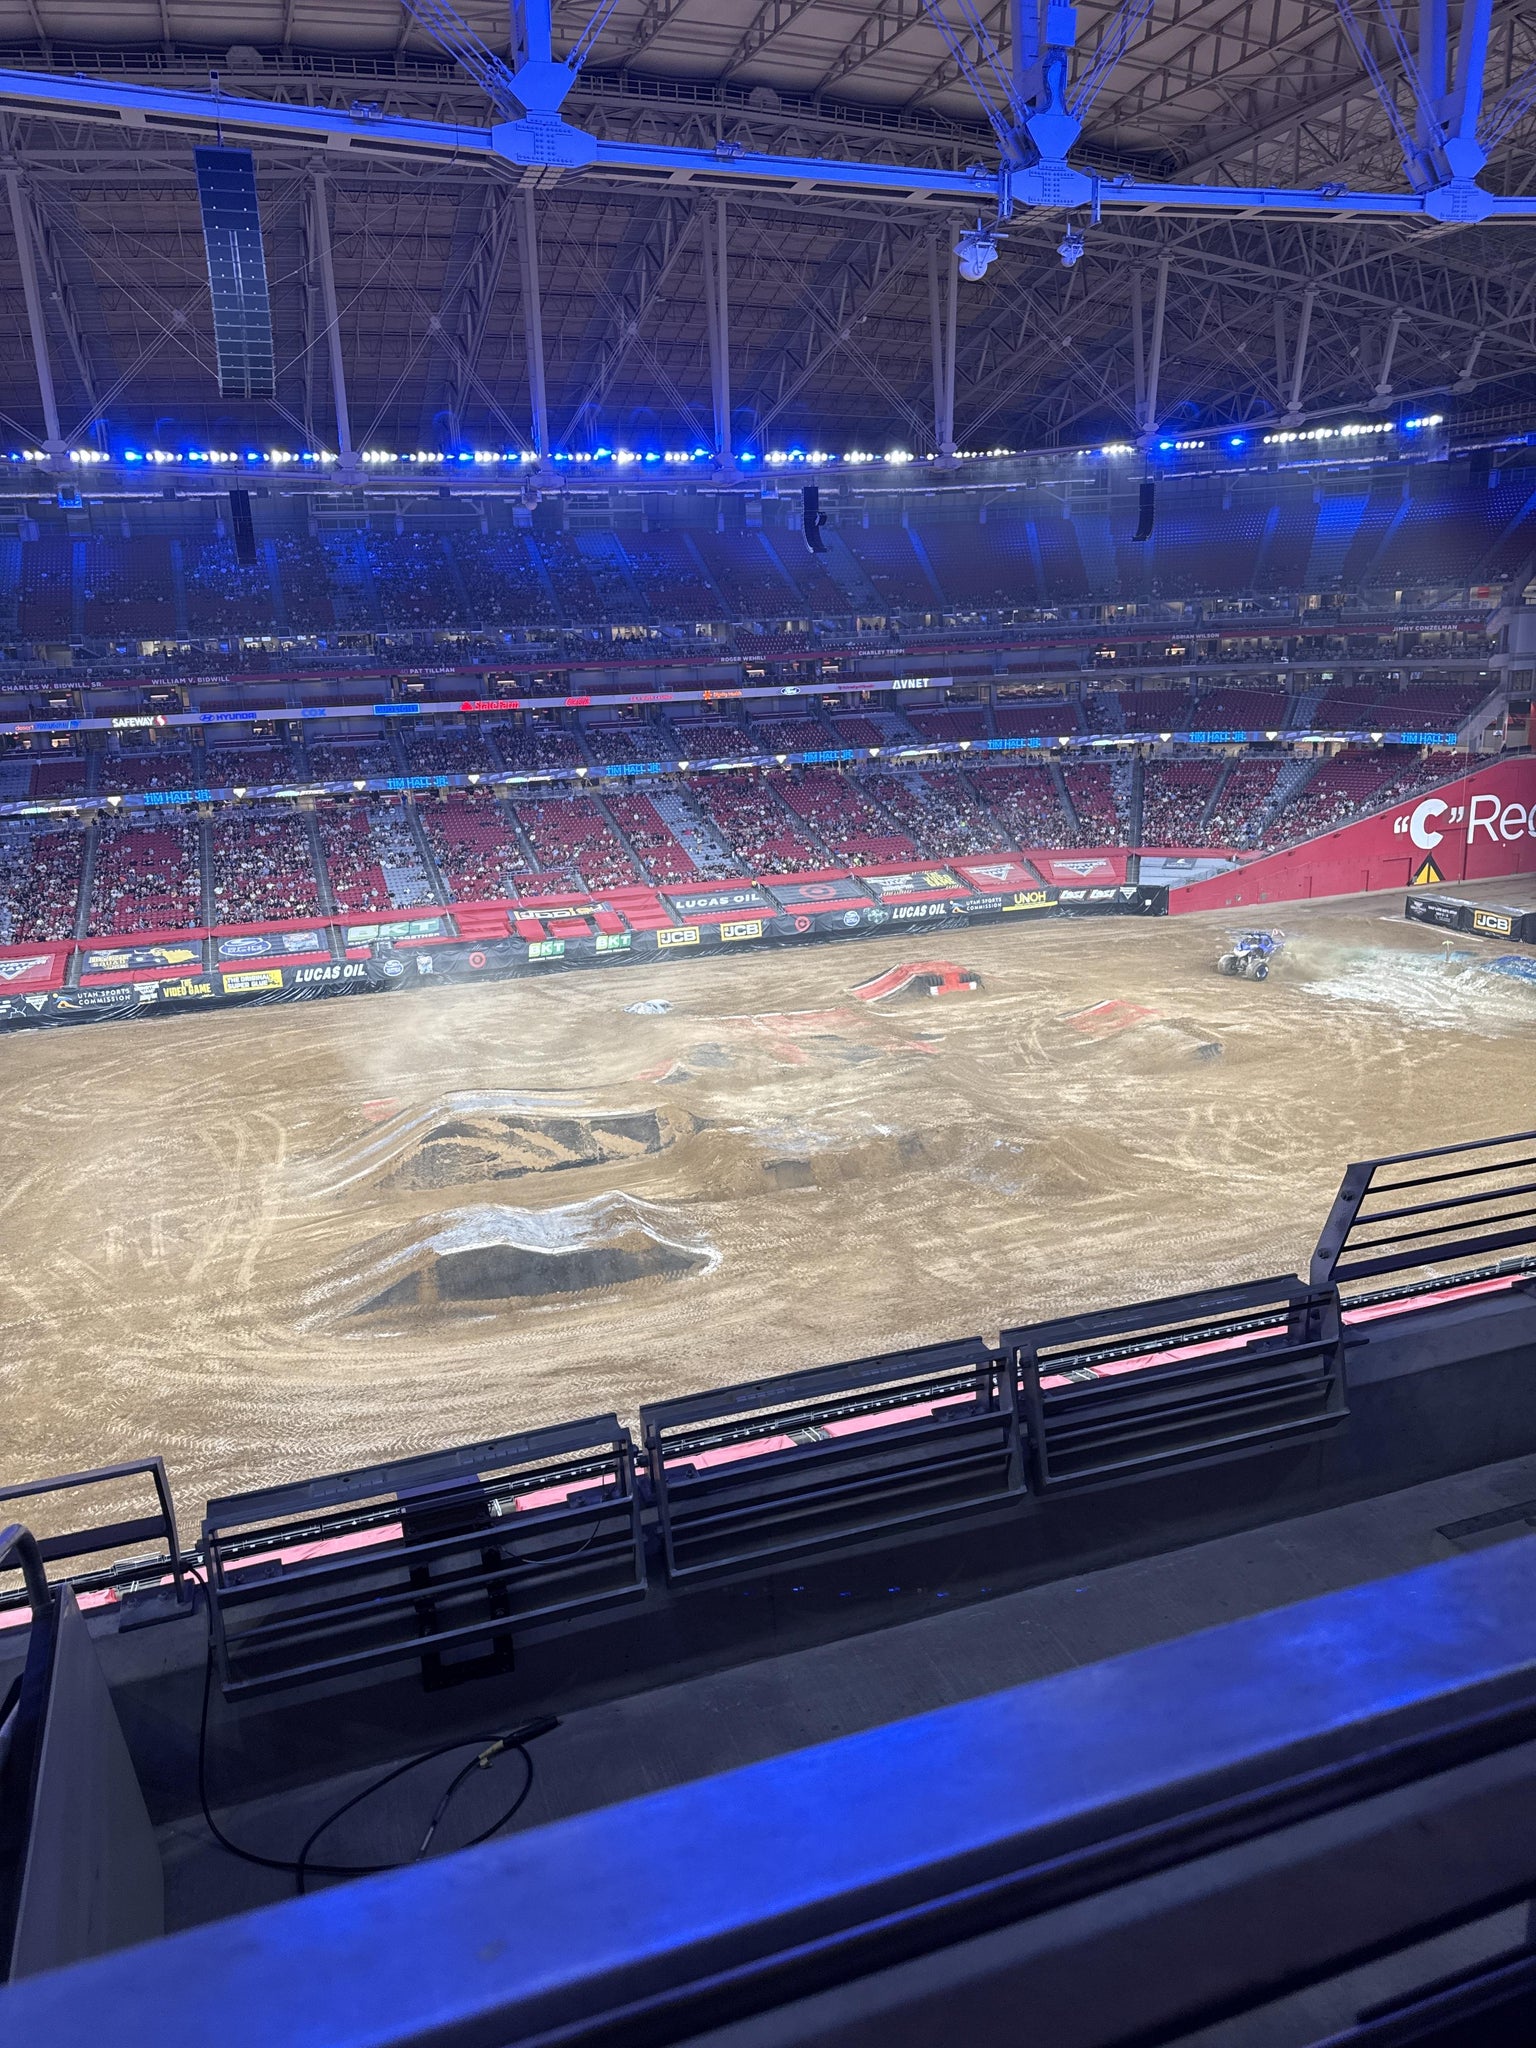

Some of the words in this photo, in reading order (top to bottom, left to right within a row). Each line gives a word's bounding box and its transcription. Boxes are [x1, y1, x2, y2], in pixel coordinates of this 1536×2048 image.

[892, 678, 930, 689] AVNET
[217, 712, 257, 721] HYUNDAI
[301, 708, 326, 717] COX
[112, 716, 154, 727] SAFEWAY
[1189, 731, 1205, 742] TIM
[1207, 731, 1230, 742] HALL
[1401, 732, 1417, 744] TIM
[1419, 732, 1443, 744] HALL
[988, 739, 1002, 749] TIM
[1004, 738, 1026, 749] HALL
[803, 752, 817, 763] TIM
[819, 751, 839, 761] HALL
[606, 765, 621, 776] TIM
[623, 764, 646, 775] HALL
[387, 778, 404, 790] TIM
[407, 777, 432, 788] HALL
[144, 793, 163, 805] TIM
[166, 791, 193, 803] HALL
[1467, 794, 1536, 844] Re
[676, 897, 728, 908] LUCAS
[1014, 891, 1046, 904] UNOH
[893, 905, 927, 919] LUCAS
[967, 903, 1001, 911] COMMISSION
[1477, 915, 1508, 930] JCB
[349, 920, 439, 939] BKT
[661, 930, 696, 943] JCB
[724, 923, 758, 937] JCB
[597, 935, 631, 948] BKT
[529, 942, 564, 956] BKT
[295, 966, 341, 982] LUCAS
[180, 979, 192, 987] THE
[77, 991, 99, 999] UTAH
[102, 988, 130, 996] SPORTS
[163, 986, 187, 997] VIDEO
[188, 983, 212, 995] GAME
[78, 995, 131, 1006] COMMISSION
